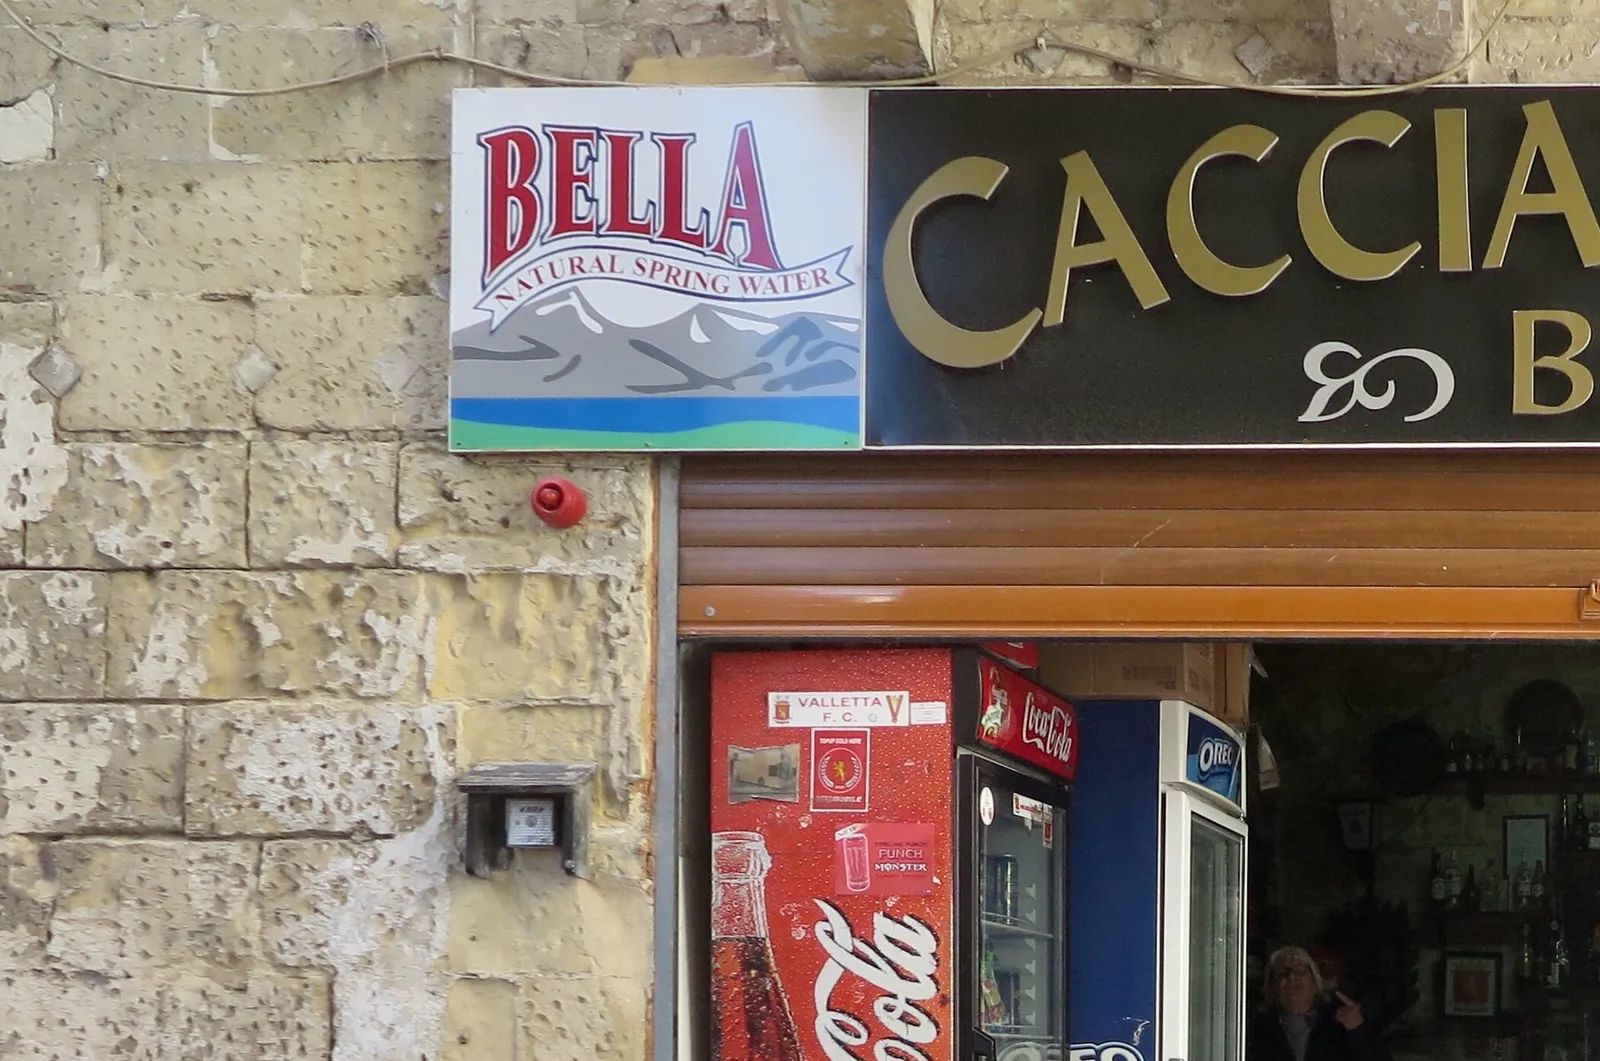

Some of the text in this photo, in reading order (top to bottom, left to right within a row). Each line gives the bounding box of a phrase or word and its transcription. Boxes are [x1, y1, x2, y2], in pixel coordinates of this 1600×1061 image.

[476, 120, 784, 292] BELLA
[495, 255, 833, 309] NATURAL SPRING WATER
[798, 696, 882, 708] VALLETTA
[879, 849, 922, 859] PUNCH
[875, 862, 928, 872] MONSTER
